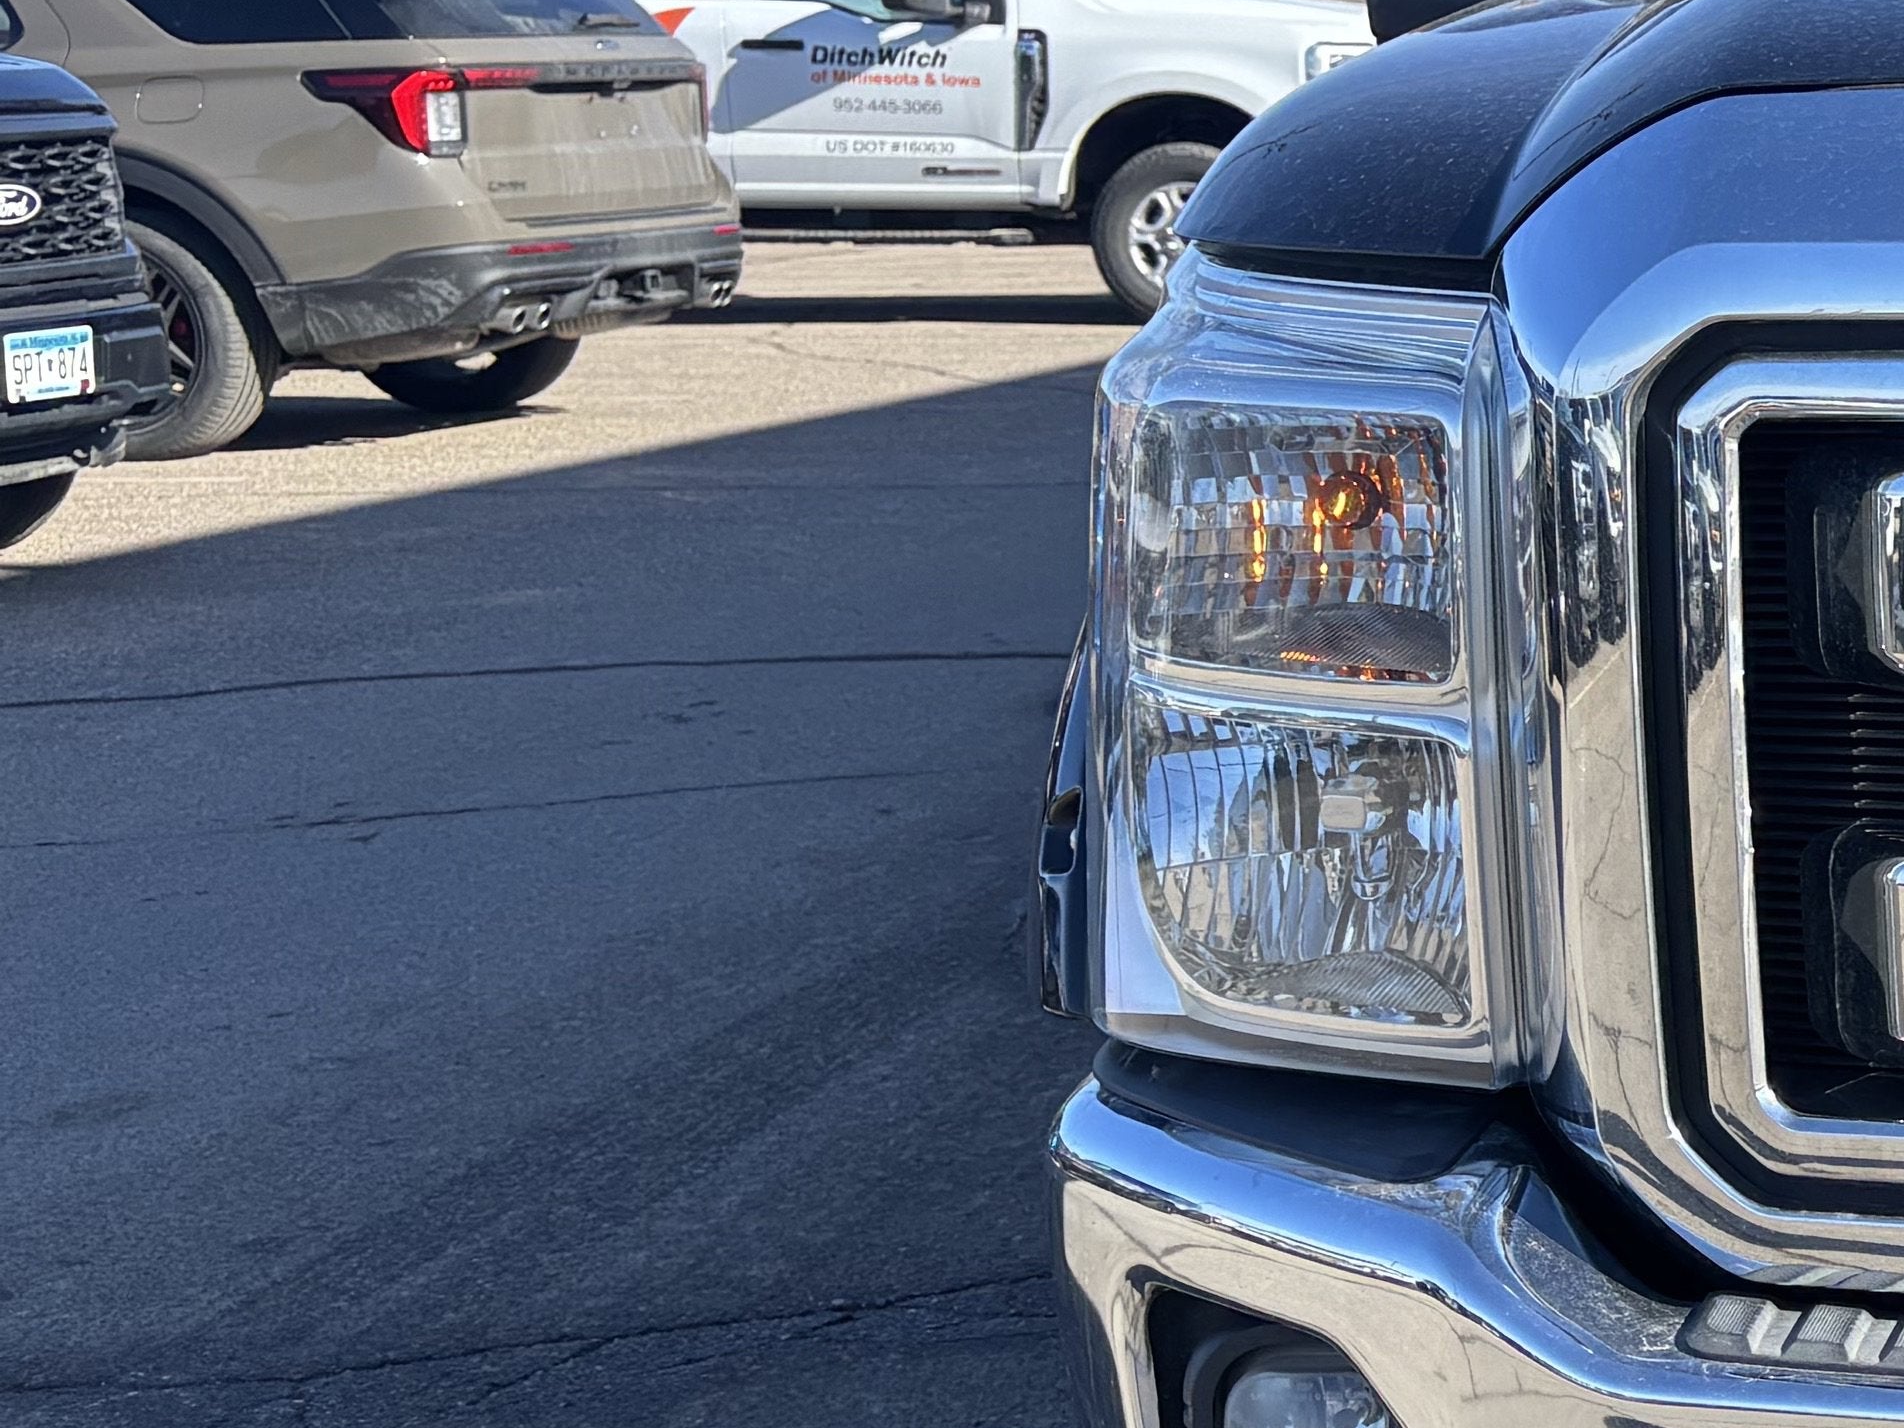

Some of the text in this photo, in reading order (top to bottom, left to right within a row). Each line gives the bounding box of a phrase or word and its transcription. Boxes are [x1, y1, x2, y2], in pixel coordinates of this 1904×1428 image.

[811, 71, 981, 88] of Minnesota & Iowa
[826, 140, 848, 153] US
[853, 140, 885, 153] DOT
